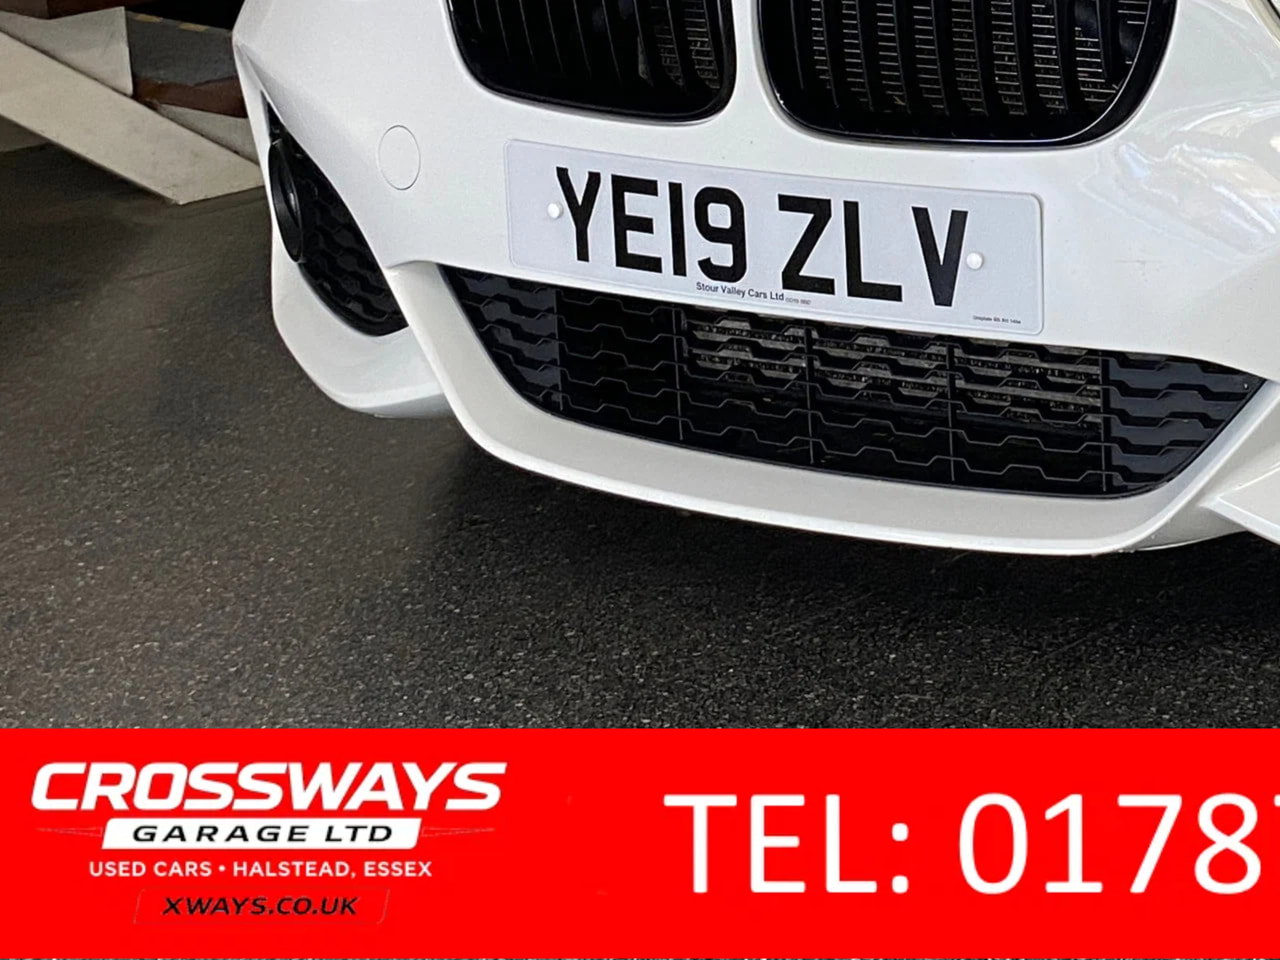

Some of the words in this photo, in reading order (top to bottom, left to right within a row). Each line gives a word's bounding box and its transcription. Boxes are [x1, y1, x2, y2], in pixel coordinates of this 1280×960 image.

[556, 166, 748, 283] YE19
[777, 193, 969, 307] ZLV
[696, 281, 719, 293] Stour
[720, 285, 746, 298] Valley
[747, 288, 768, 300] Cars
[769, 291, 785, 301] Ltd
